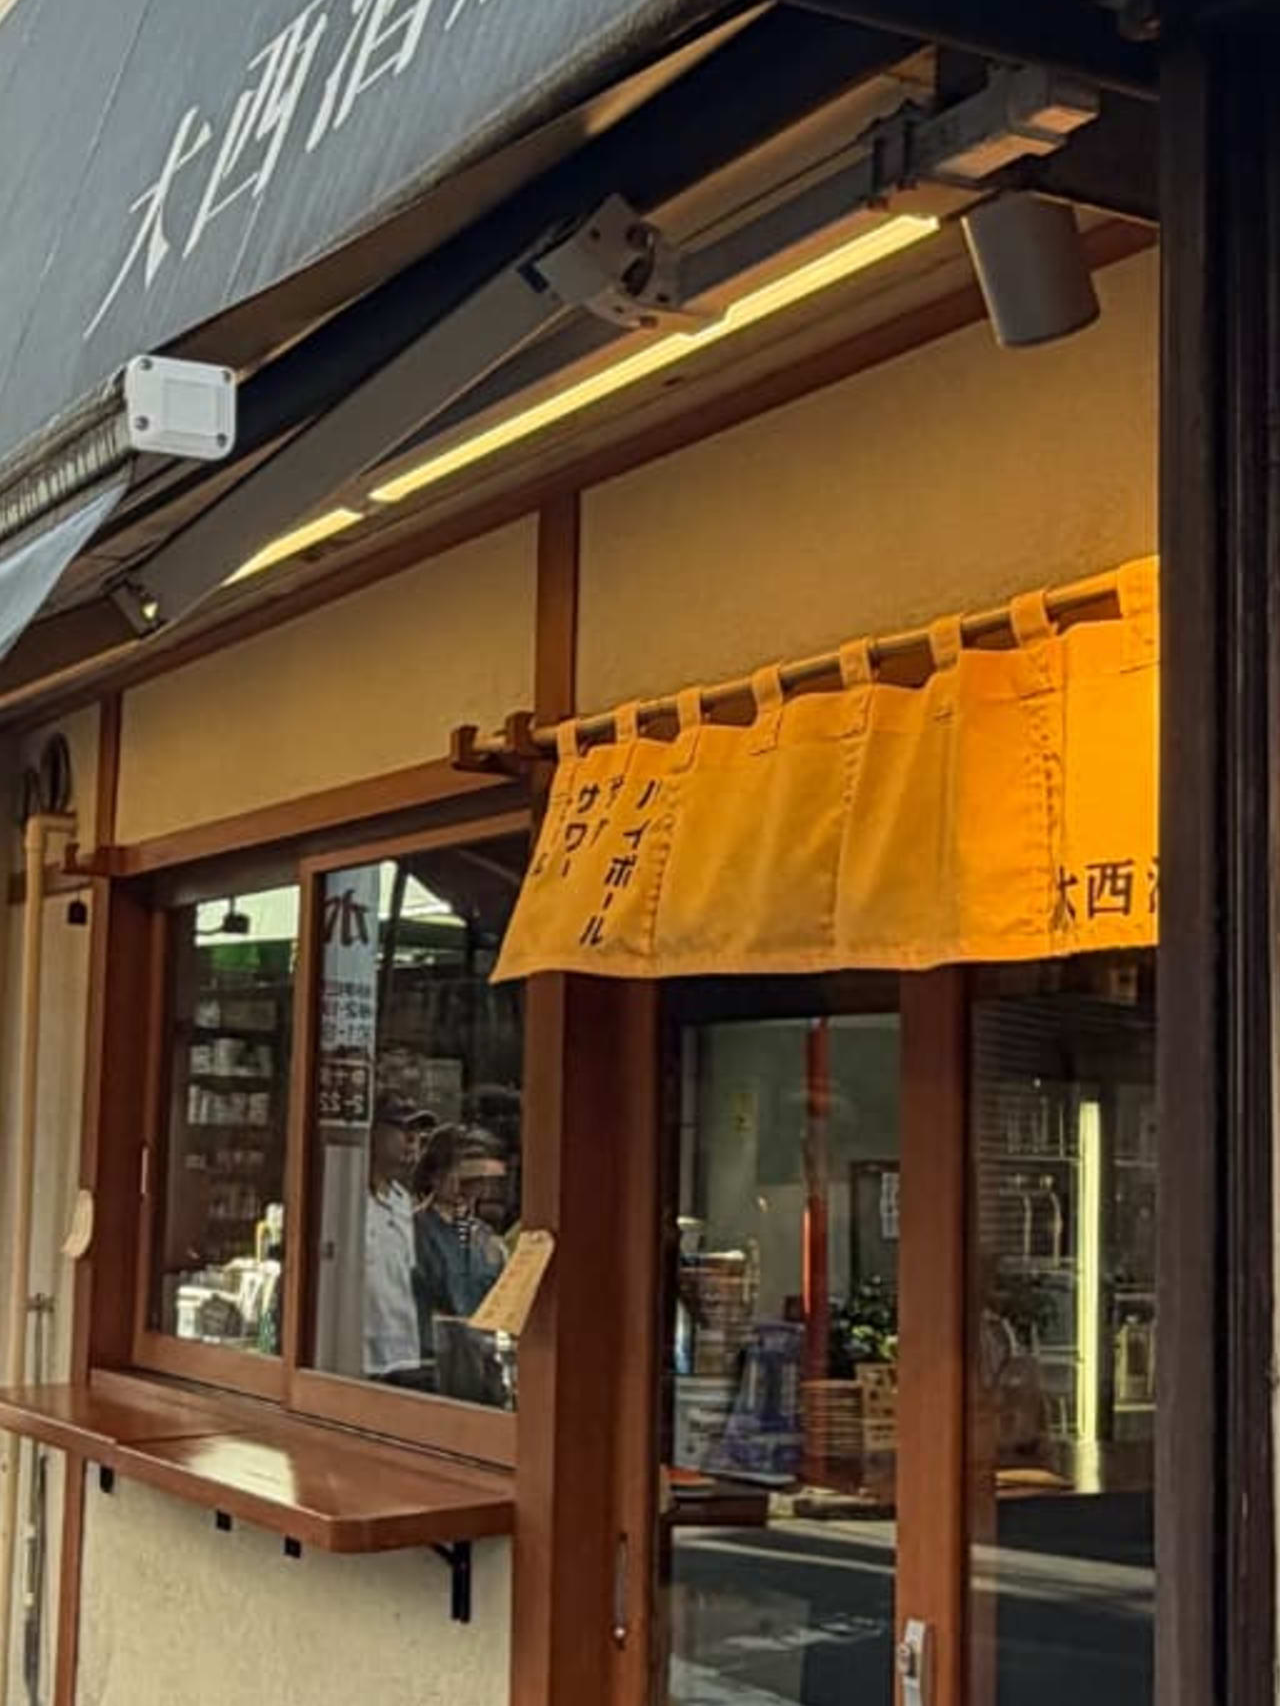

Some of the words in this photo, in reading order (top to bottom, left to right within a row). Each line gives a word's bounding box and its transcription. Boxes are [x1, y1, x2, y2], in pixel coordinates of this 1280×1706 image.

[561, 783, 600, 877] サワー
[578, 779, 662, 946] ハイボール
